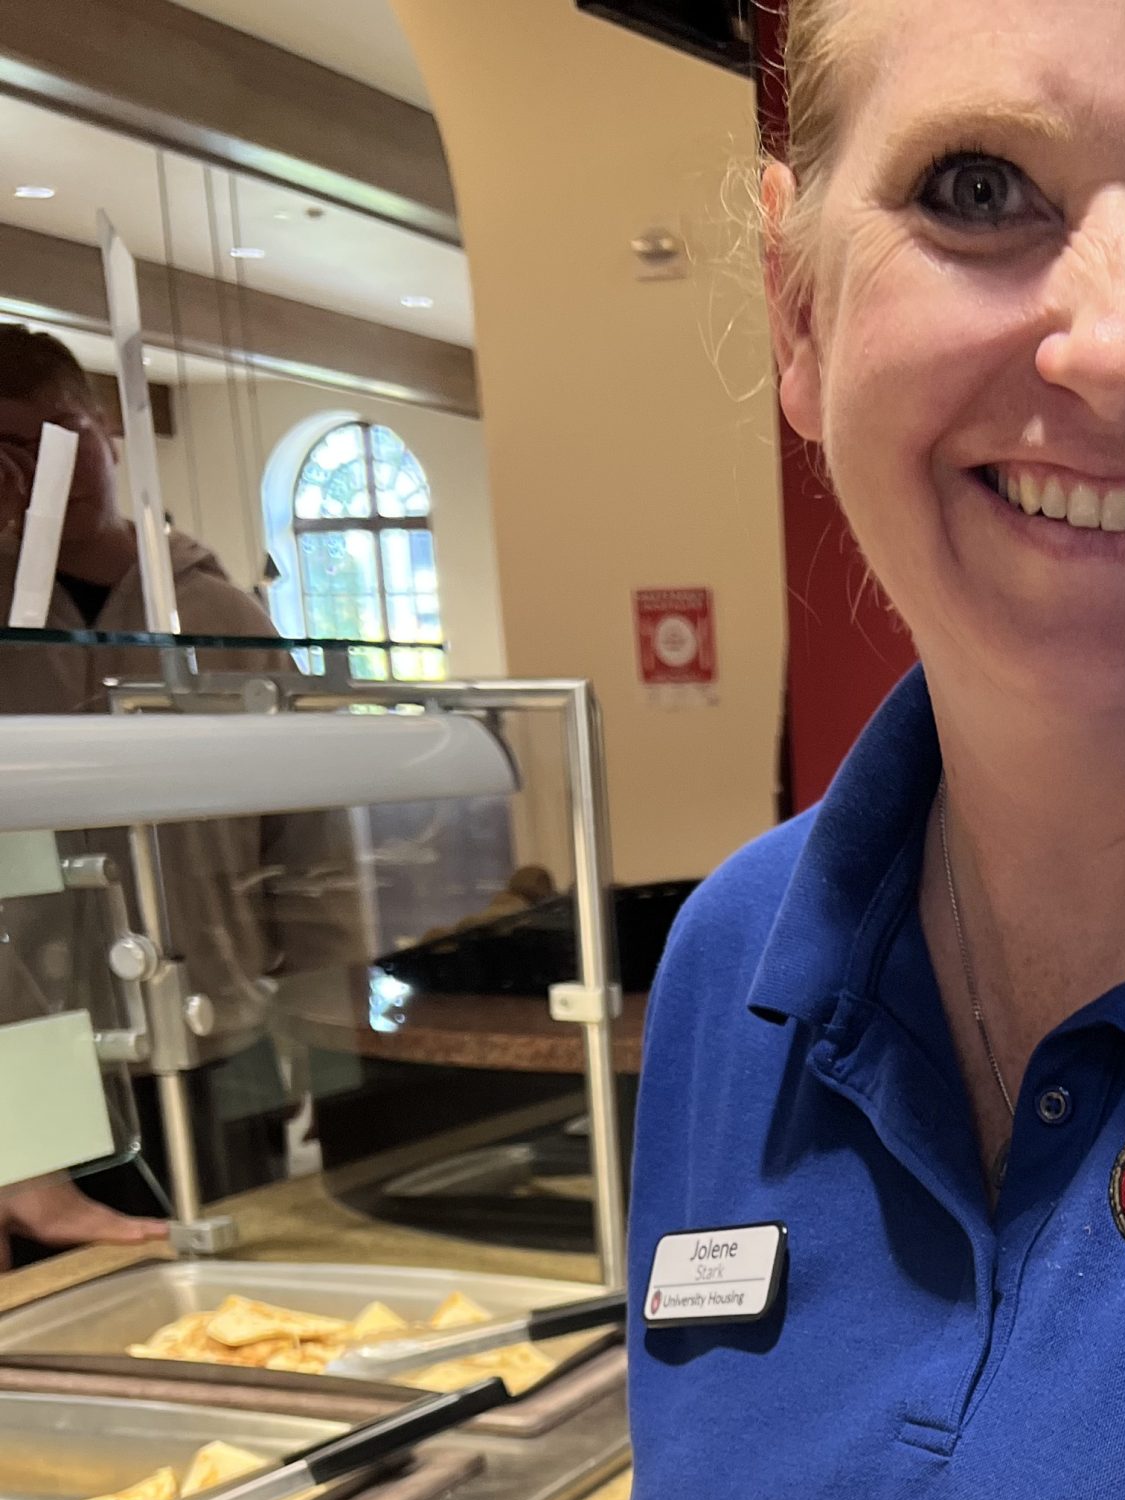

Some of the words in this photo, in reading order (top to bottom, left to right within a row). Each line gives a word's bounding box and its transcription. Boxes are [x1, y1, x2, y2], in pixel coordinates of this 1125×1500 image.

[690, 1238, 738, 1261] Jolene
[695, 1264, 725, 1281] Stark
[663, 1293, 706, 1308] University
[708, 1290, 744, 1306] Housing
